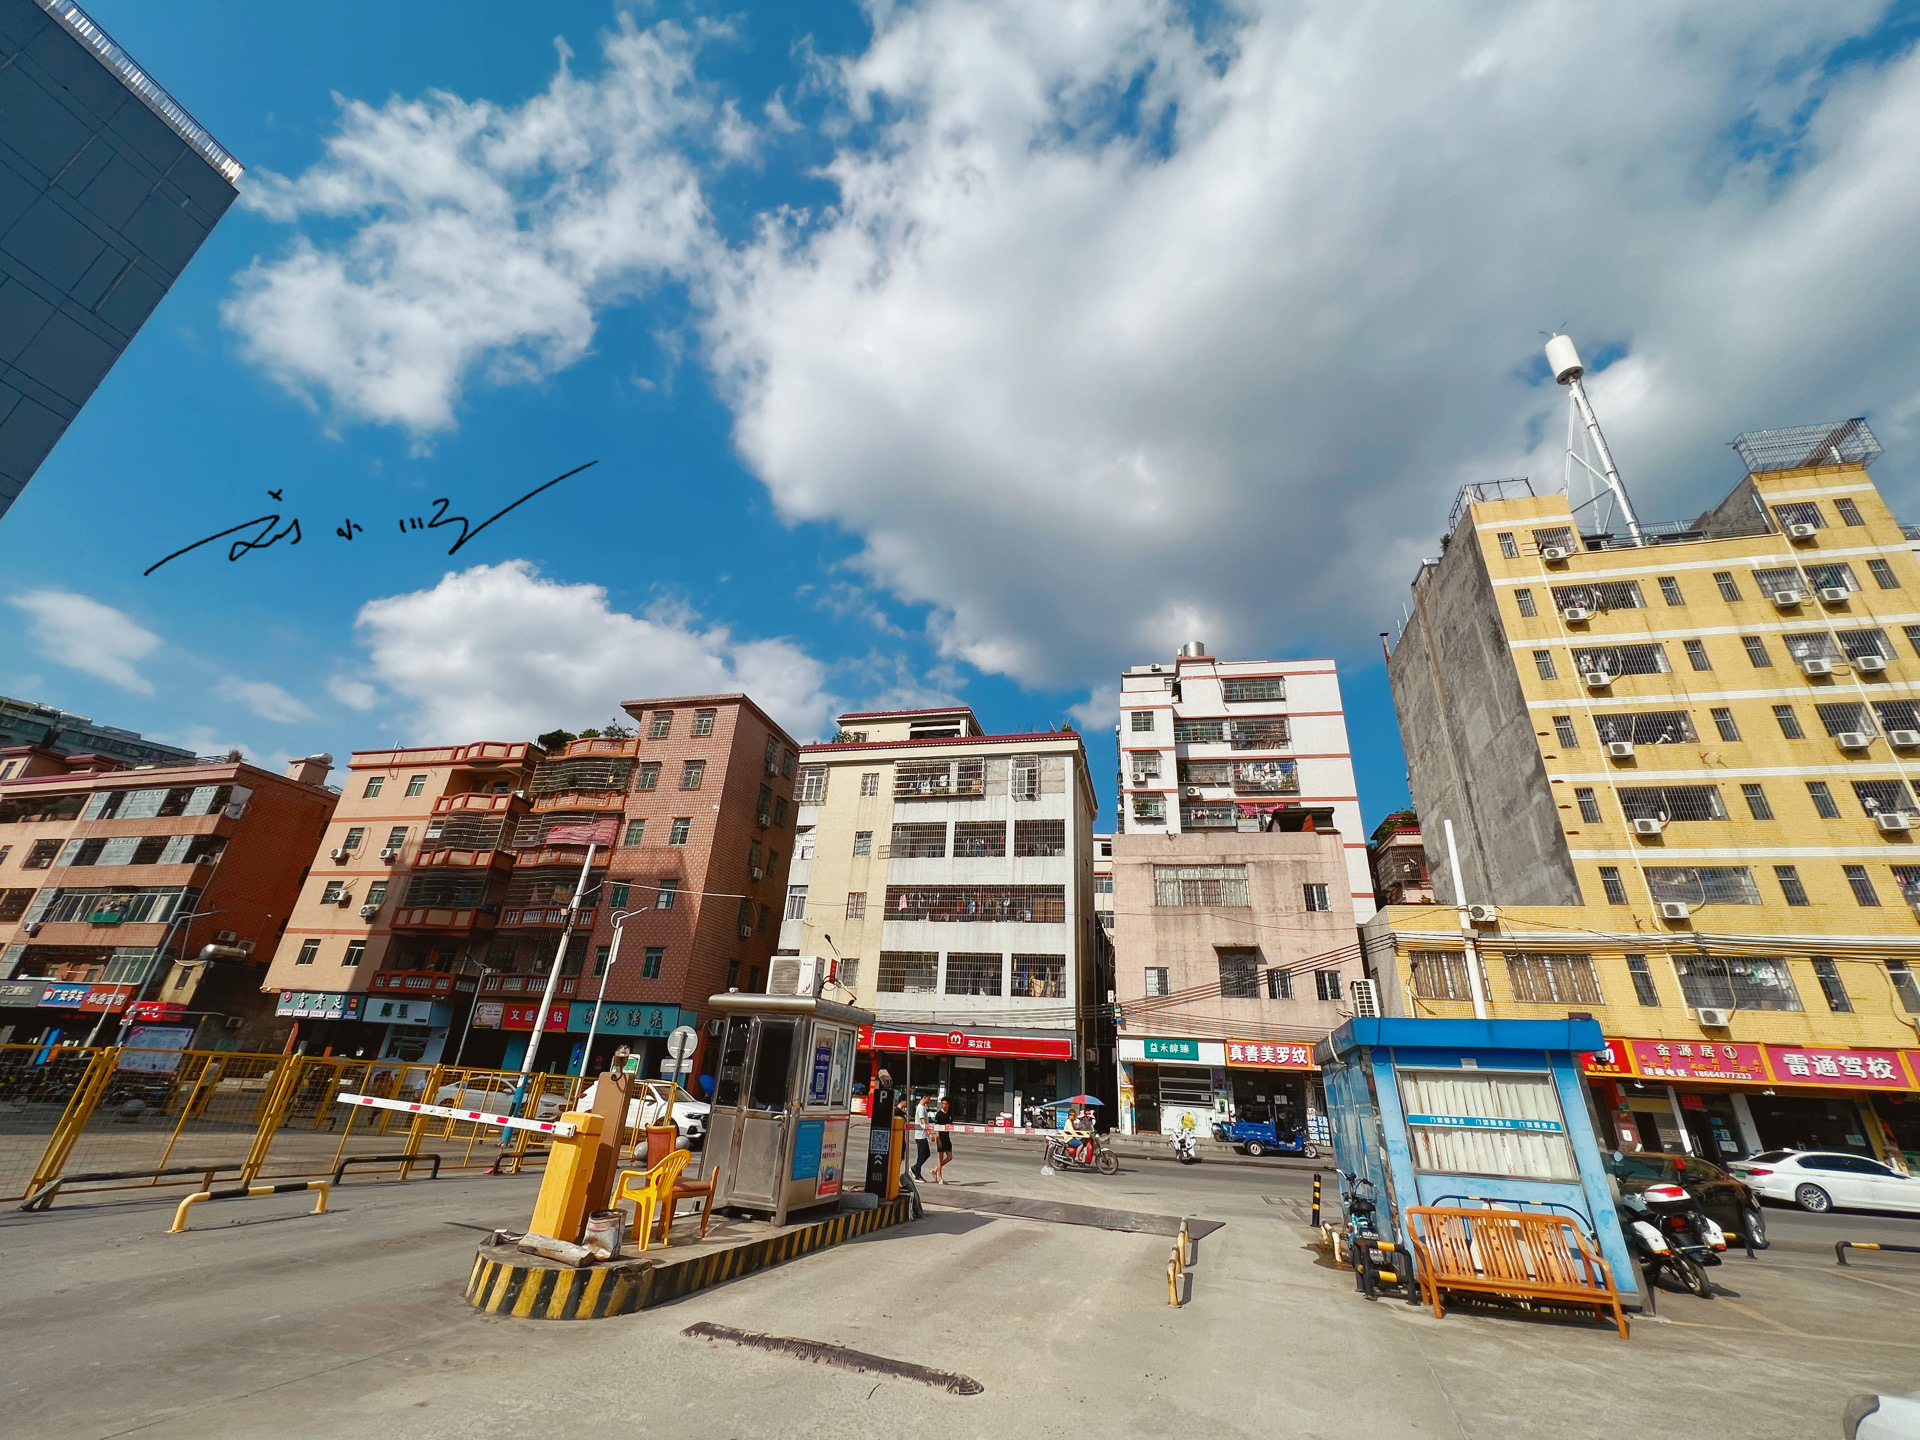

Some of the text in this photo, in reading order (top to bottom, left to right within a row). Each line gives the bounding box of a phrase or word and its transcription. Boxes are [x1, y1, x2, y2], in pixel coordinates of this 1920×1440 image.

[510, 1004, 563, 1023] 文盛钻
[968, 1039, 992, 1049] 美宜佳
[1229, 1044, 1308, 1065] 真善美罗纹
[1782, 1053, 1897, 1080] 雷通驾校
[879, 1090, 888, 1103] P
